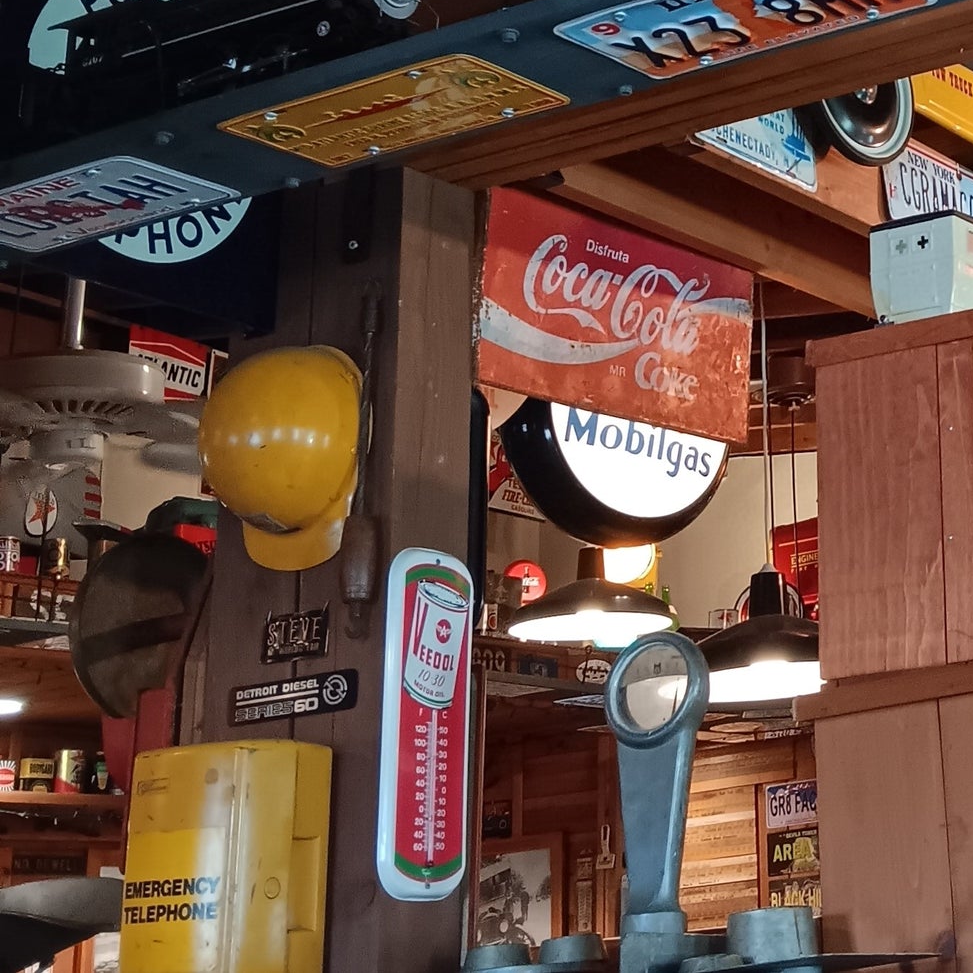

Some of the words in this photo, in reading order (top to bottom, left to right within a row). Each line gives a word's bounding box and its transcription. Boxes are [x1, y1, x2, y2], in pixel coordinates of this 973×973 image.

[948, 71, 973, 98] TRUCK
[906, 150, 929, 170] NEW
[931, 162, 956, 185] YORK
[585, 238, 631, 264] Disfruta
[522, 233, 711, 355] Coca-Cola
[564, 406, 713, 479] Mobilgas
[266, 615, 322, 645] STEVE
[236, 683, 279, 701] DETROIT
[282, 678, 320, 693] DIESEL
[769, 794, 792, 817] GR8
[125, 876, 221, 900] EMERGENCY
[124, 901, 219, 925] TELEPHONE
